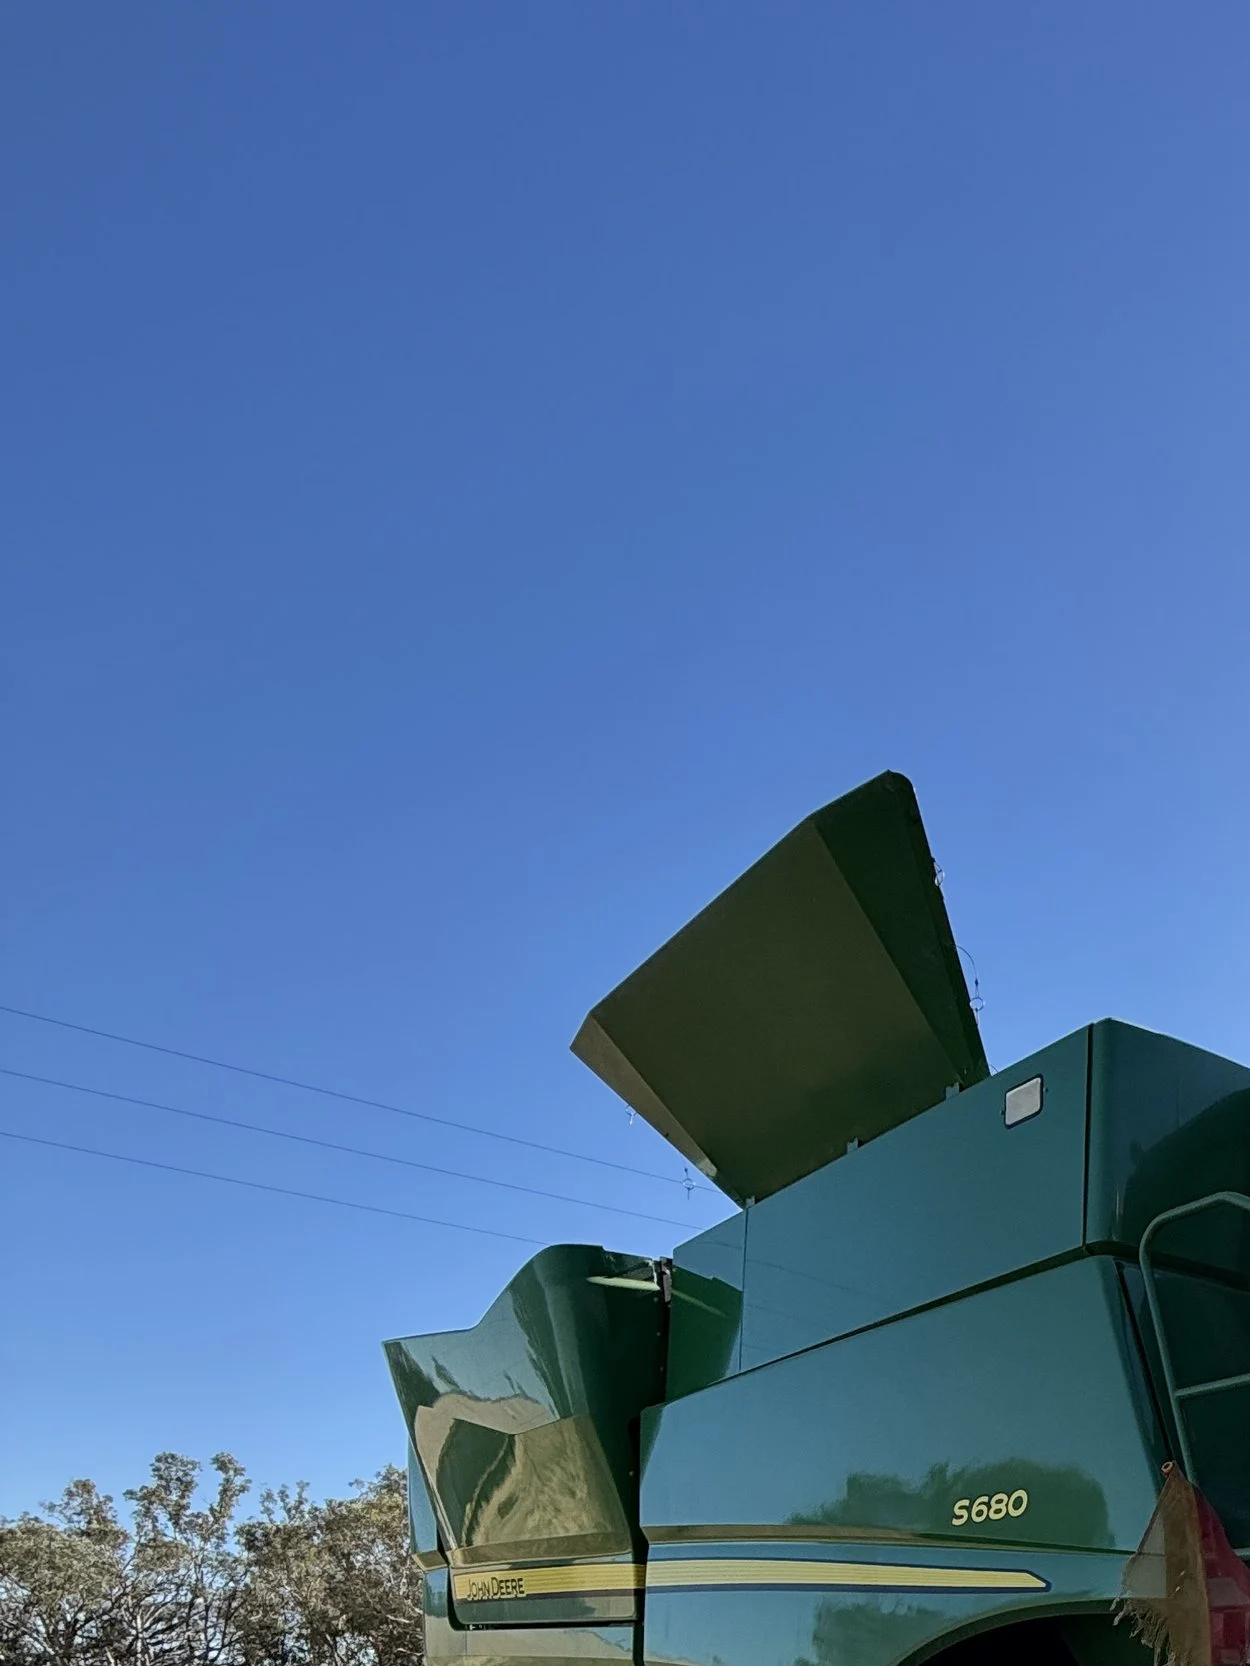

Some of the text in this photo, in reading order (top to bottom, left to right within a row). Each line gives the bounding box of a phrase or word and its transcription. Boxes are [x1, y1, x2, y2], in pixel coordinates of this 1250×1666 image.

[951, 1489, 1028, 1526] S680
[466, 1576, 525, 1599] JOHN DEERE
